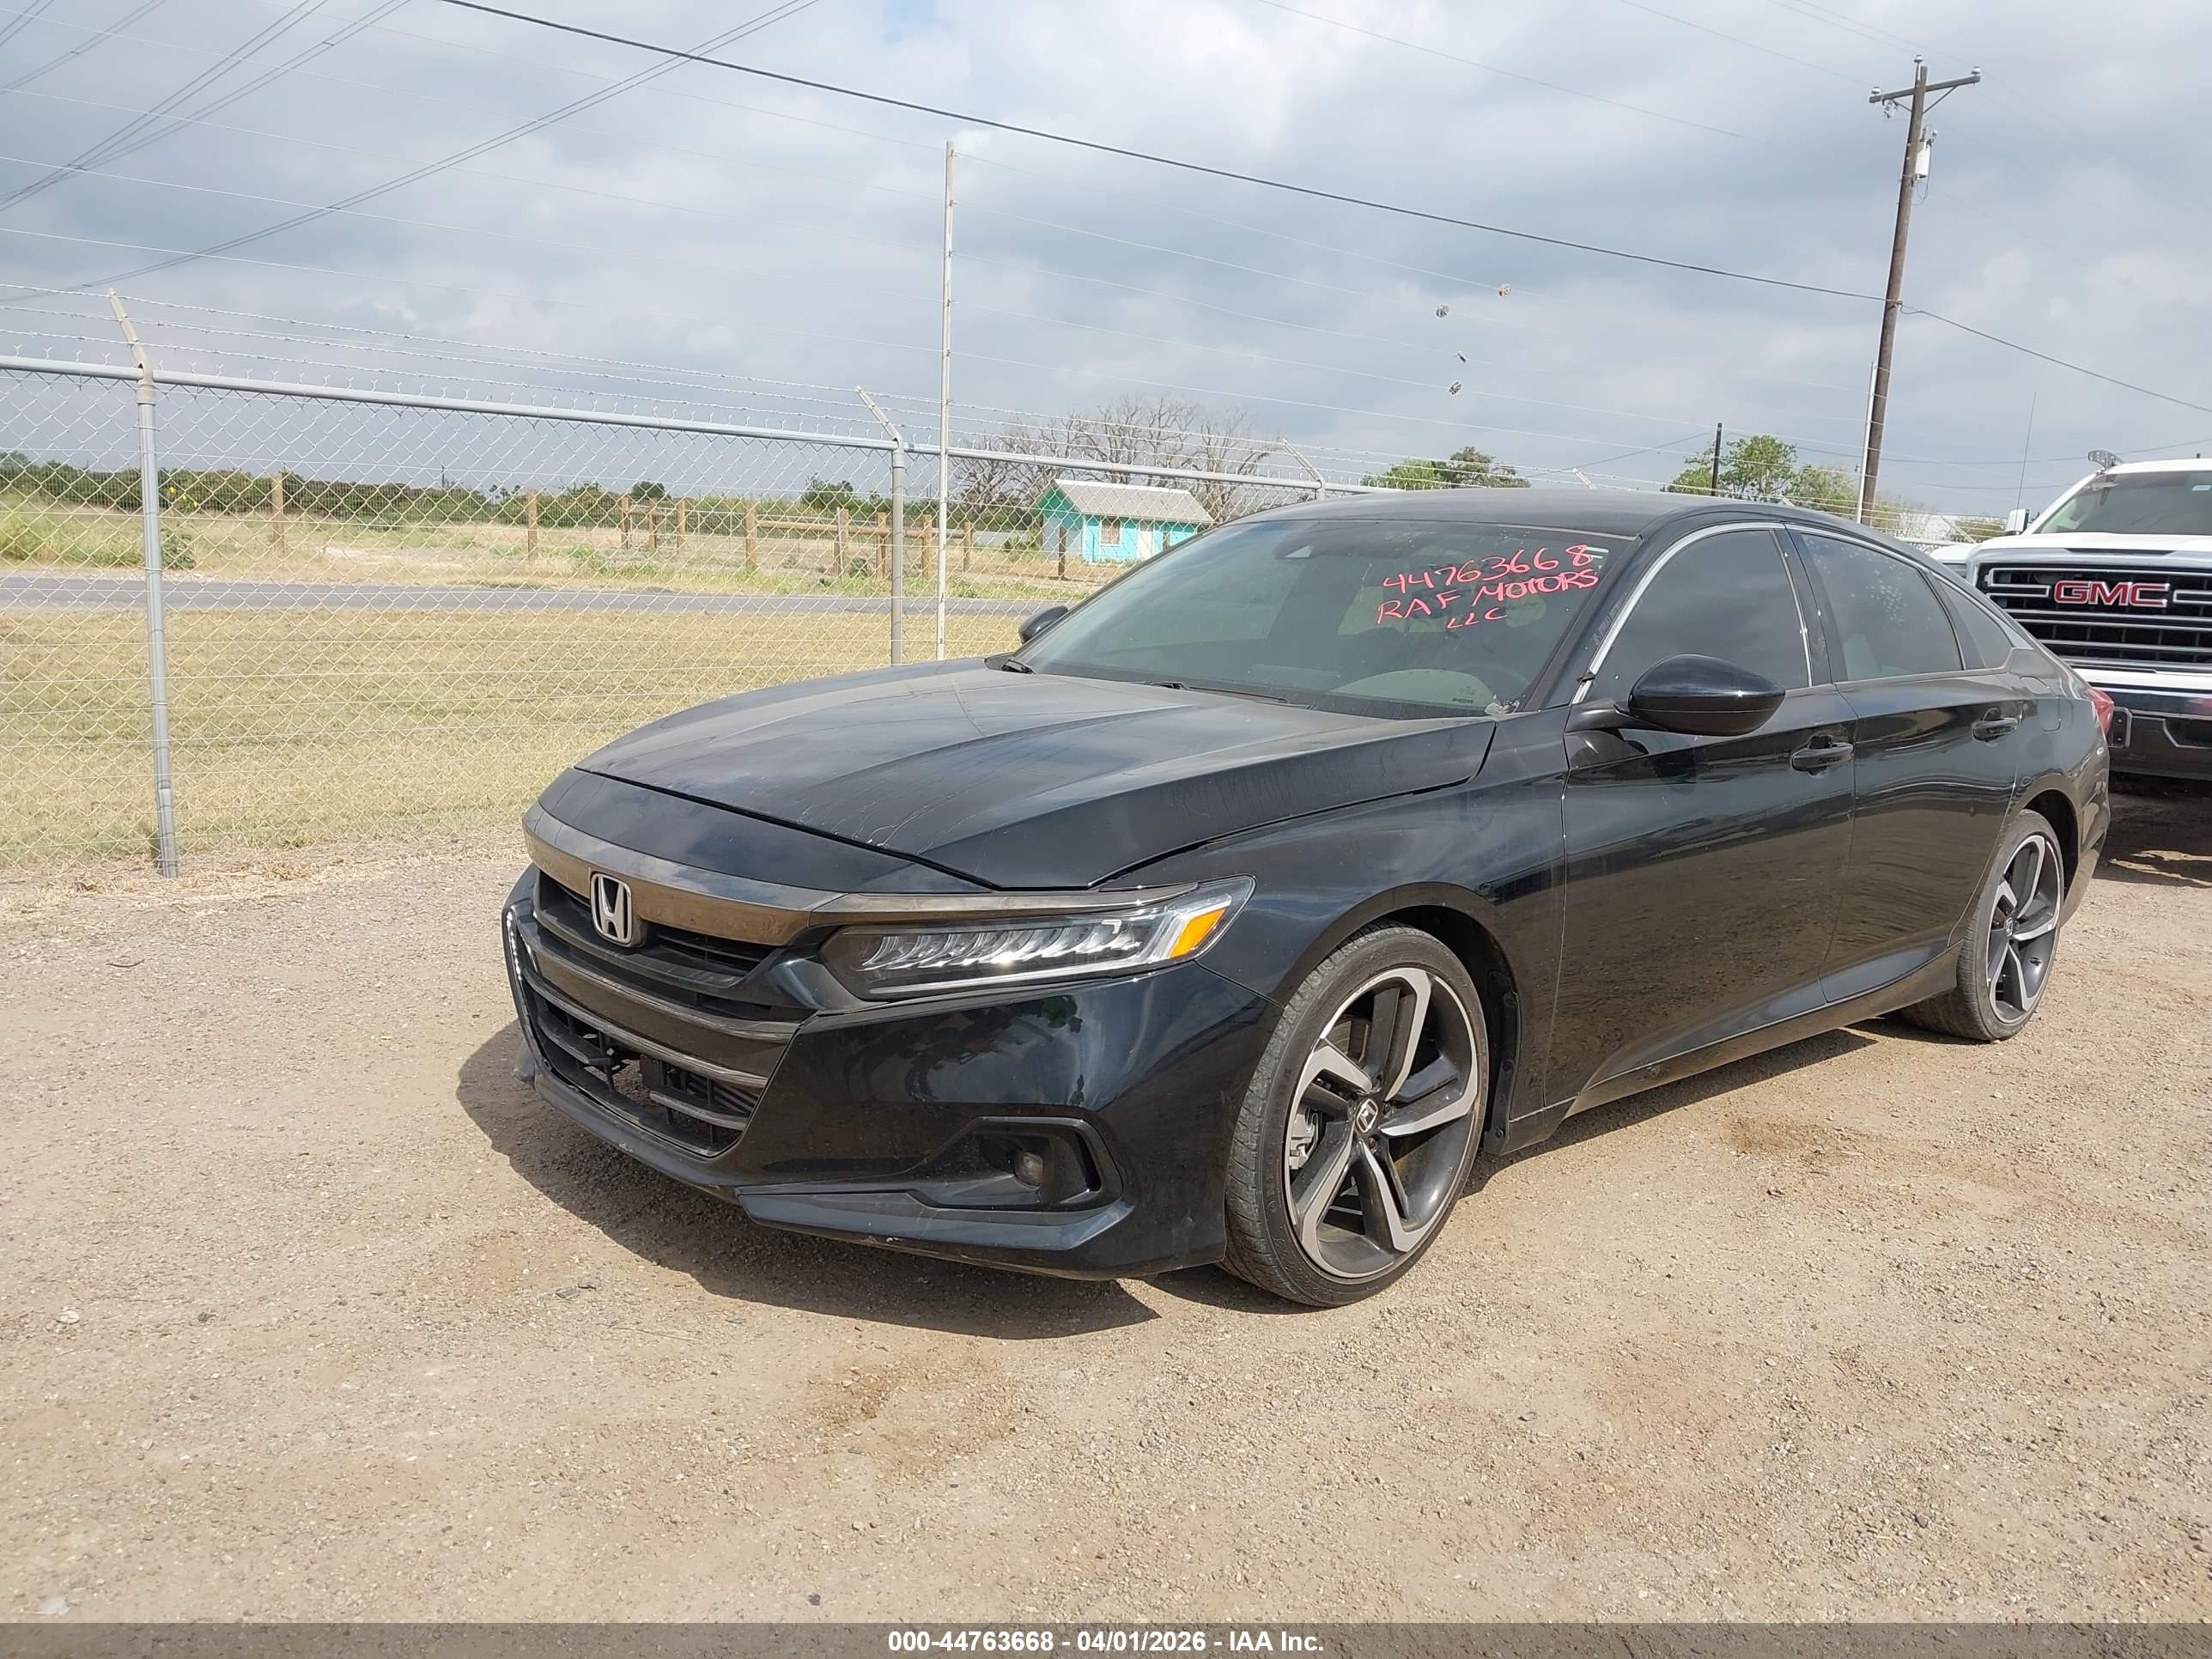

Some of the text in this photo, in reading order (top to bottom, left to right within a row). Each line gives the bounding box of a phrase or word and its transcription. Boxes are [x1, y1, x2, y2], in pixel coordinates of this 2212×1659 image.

[1382, 544, 1593, 593] 44763668
[1377, 568, 1599, 624] RAF MOTORS
[2054, 580, 2170, 607] GMC
[1446, 606, 1508, 629] LLC
